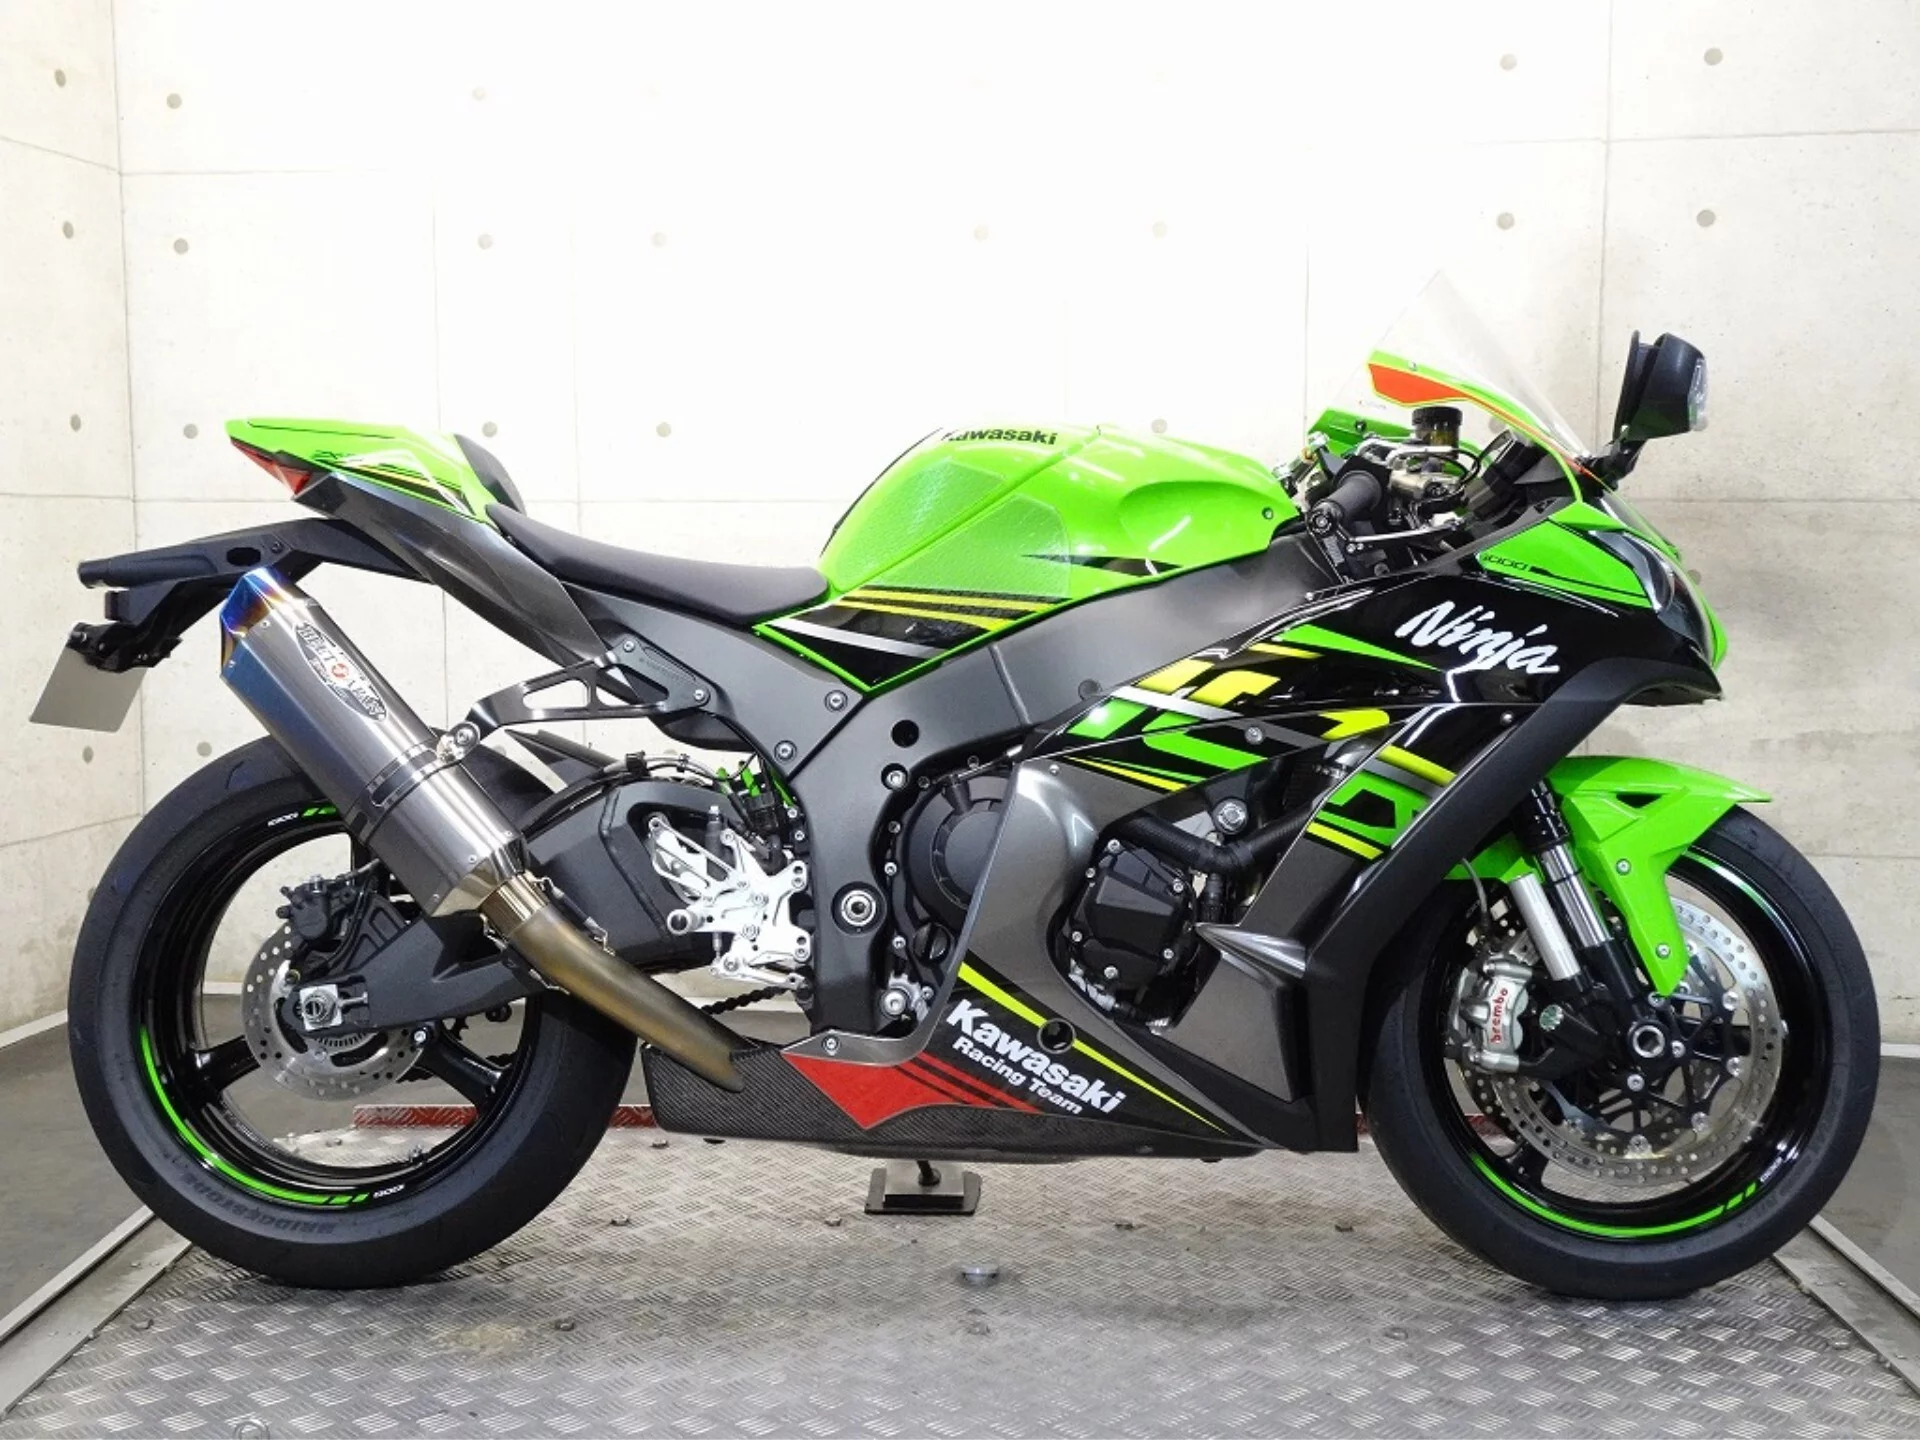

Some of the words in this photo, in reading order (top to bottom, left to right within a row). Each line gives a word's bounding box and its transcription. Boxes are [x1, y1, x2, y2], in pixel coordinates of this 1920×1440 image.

[1395, 600, 1560, 674] Ninja
[1490, 987, 1509, 1044] brembo
[946, 999, 1127, 1113] Kawasaki
[952, 1036, 1027, 1086] Racing
[1028, 1077, 1083, 1114] Team
